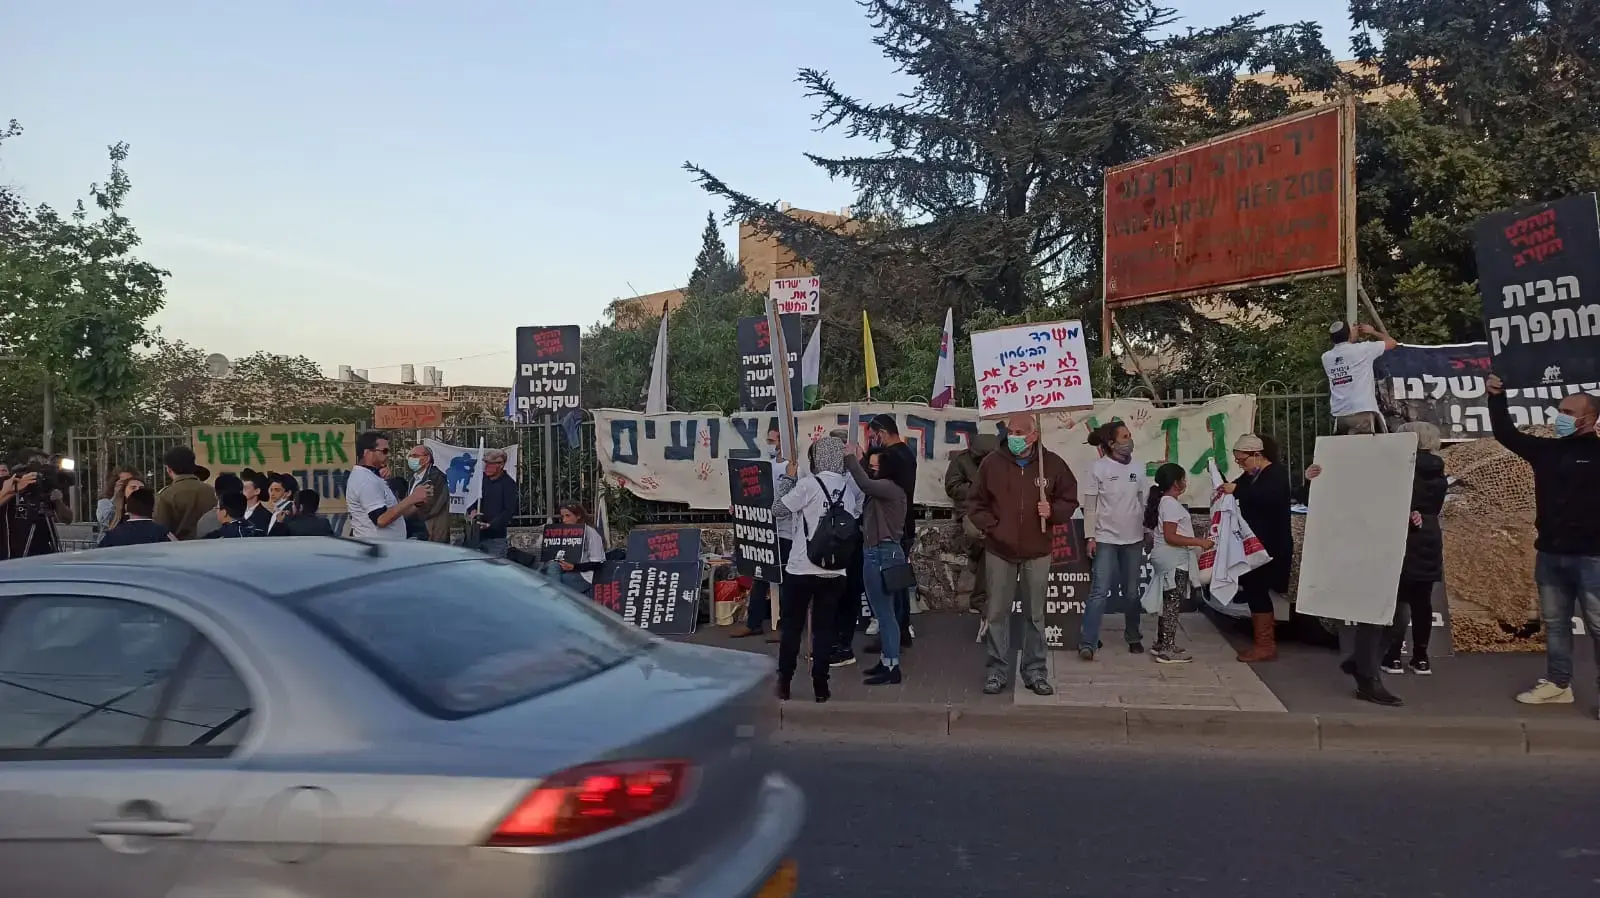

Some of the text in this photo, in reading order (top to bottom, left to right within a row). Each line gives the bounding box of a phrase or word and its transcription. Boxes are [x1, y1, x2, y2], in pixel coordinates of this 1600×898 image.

[790, 291, 807, 300] את
[1502, 275, 1580, 309] הבית
[777, 301, 808, 312] המשר
[1029, 327, 1078, 348] משרד
[1489, 303, 1600, 356] מתפרק
[978, 351, 1077, 382] לא מייצג את
[999, 346, 1047, 367] הביטחון
[521, 361, 576, 376] הילדים
[529, 377, 567, 393] שלנו
[982, 375, 1082, 396] הערכים עליהם
[1392, 374, 1486, 400] שלנו
[518, 395, 579, 412] שקופים
[197, 429, 349, 466] אמיר אשל
[610, 417, 799, 466] צועים
[734, 503, 773, 524] נשארנו
[562, 537, 583, 547] שקופים
[735, 523, 775, 545] פצועים
[739, 543, 775, 565] מאחור
[658, 570, 668, 585] לא
[1057, 573, 1090, 582] הממסד
[640, 567, 657, 629] לוחמים פצועים
[665, 572, 680, 622] מהעבודה
[1062, 585, 1075, 598] כי
